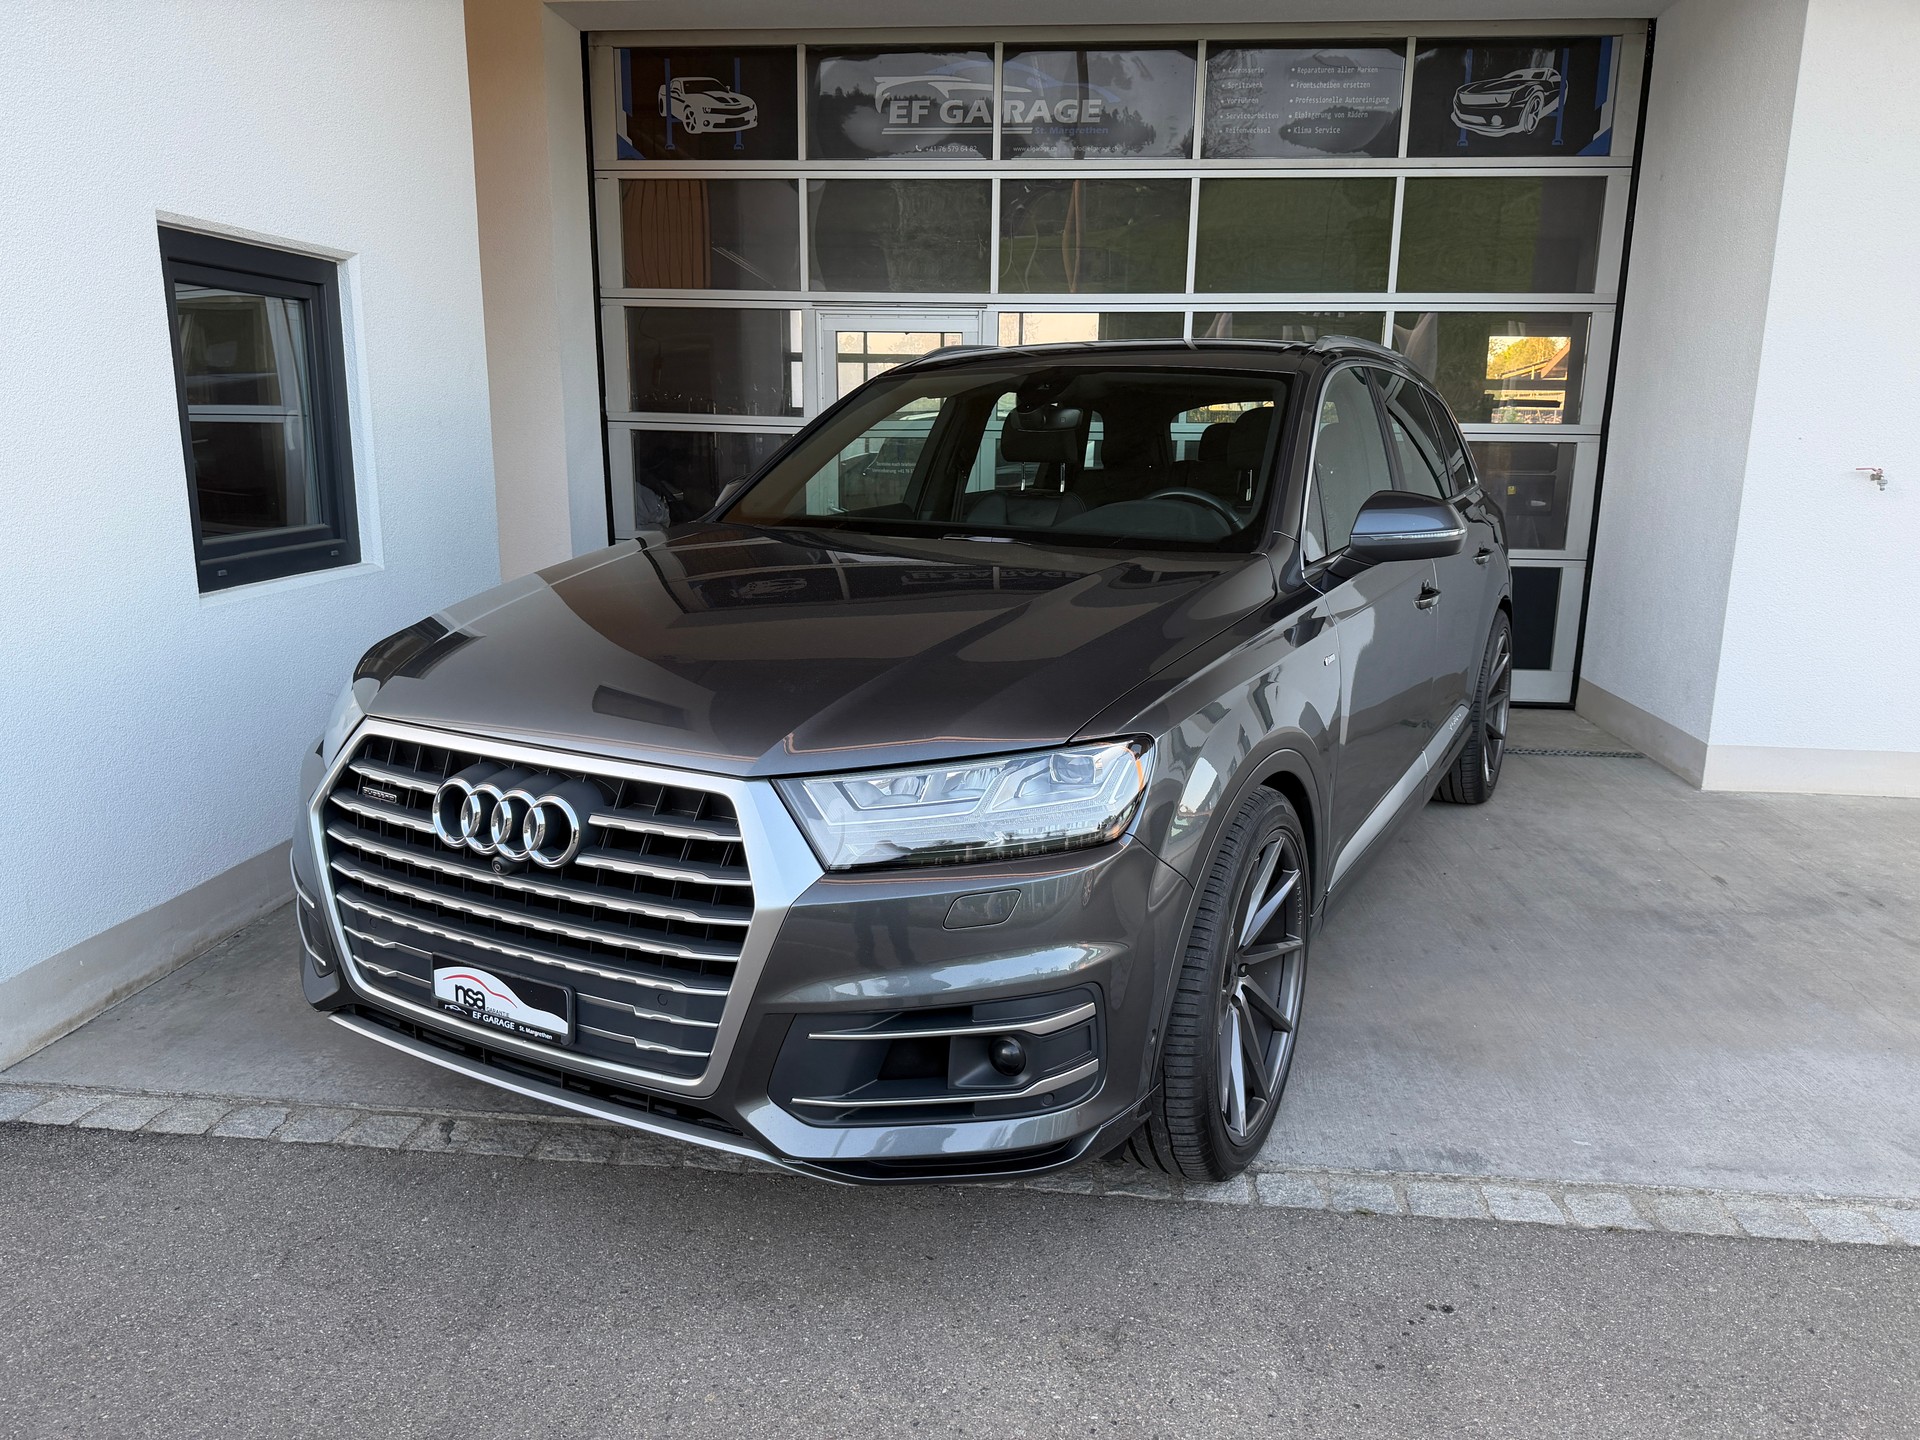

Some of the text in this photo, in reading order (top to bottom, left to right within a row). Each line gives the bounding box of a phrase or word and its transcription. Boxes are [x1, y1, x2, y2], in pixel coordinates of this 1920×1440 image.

[1297, 67, 1334, 75] Reparaturen
[1227, 81, 1263, 89] Spritzwerk
[1345, 96, 1390, 105] Autoreinigung
[889, 100, 931, 124] EF
[1295, 111, 1332, 120] Einlagerung
[1034, 126, 1109, 136] St. Margrethen
[1225, 126, 1271, 134] Reifenwechsel
[1293, 126, 1341, 134] Klima Service
[455, 983, 486, 1011] nsa
[472, 1011, 482, 1019] EF
[483, 1013, 515, 1030] GARAGE
[526, 1026, 553, 1040] Margrethen
